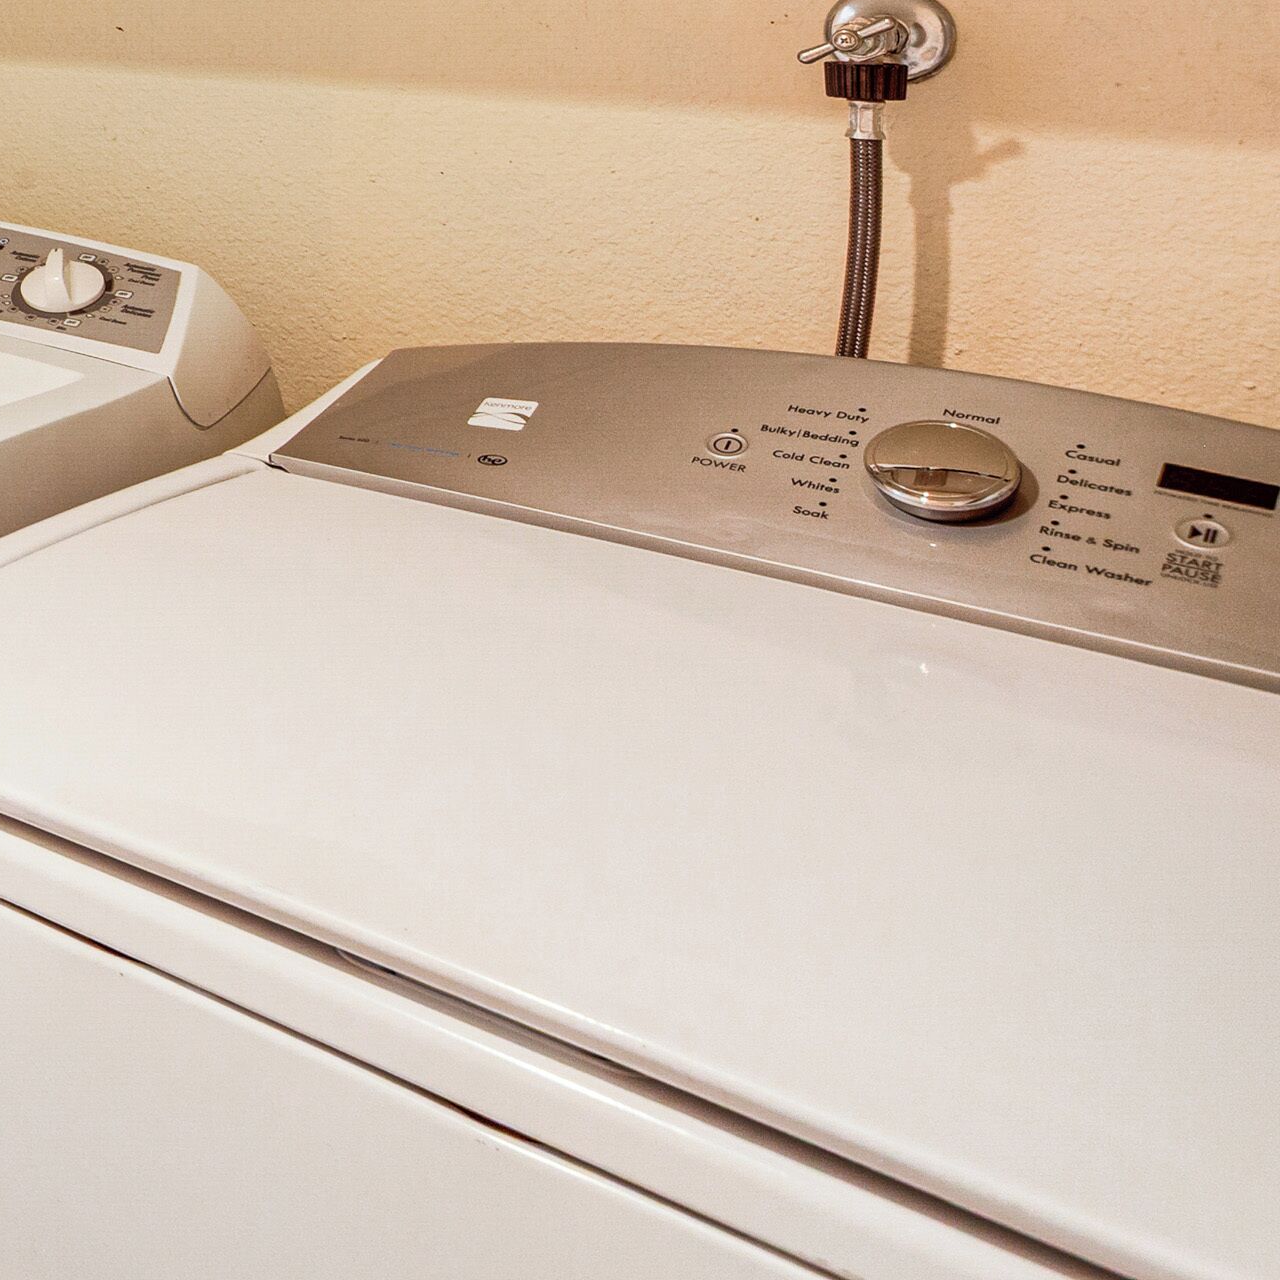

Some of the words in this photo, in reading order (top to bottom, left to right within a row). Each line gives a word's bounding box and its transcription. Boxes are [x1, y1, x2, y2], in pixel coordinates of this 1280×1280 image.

[788, 405, 832, 418] Heavy
[836, 411, 870, 424] Duty
[942, 408, 1000, 424] Normal
[691, 456, 747, 473] POWER
[772, 450, 805, 462] Cold
[809, 455, 850, 470] Clean
[1065, 450, 1121, 468] Casual
[791, 477, 840, 494] Whites
[1056, 475, 1133, 497] Delicates
[792, 506, 830, 520] Soak
[1048, 500, 1112, 520] Express
[1039, 526, 1082, 542] Rinse
[1086, 536, 1097, 545] &
[1102, 538, 1140, 554] Spin
[1029, 554, 1078, 571] Clean
[1085, 564, 1154, 587] Washer
[1166, 552, 1224, 571] START
[1161, 563, 1223, 585] PAUSE
